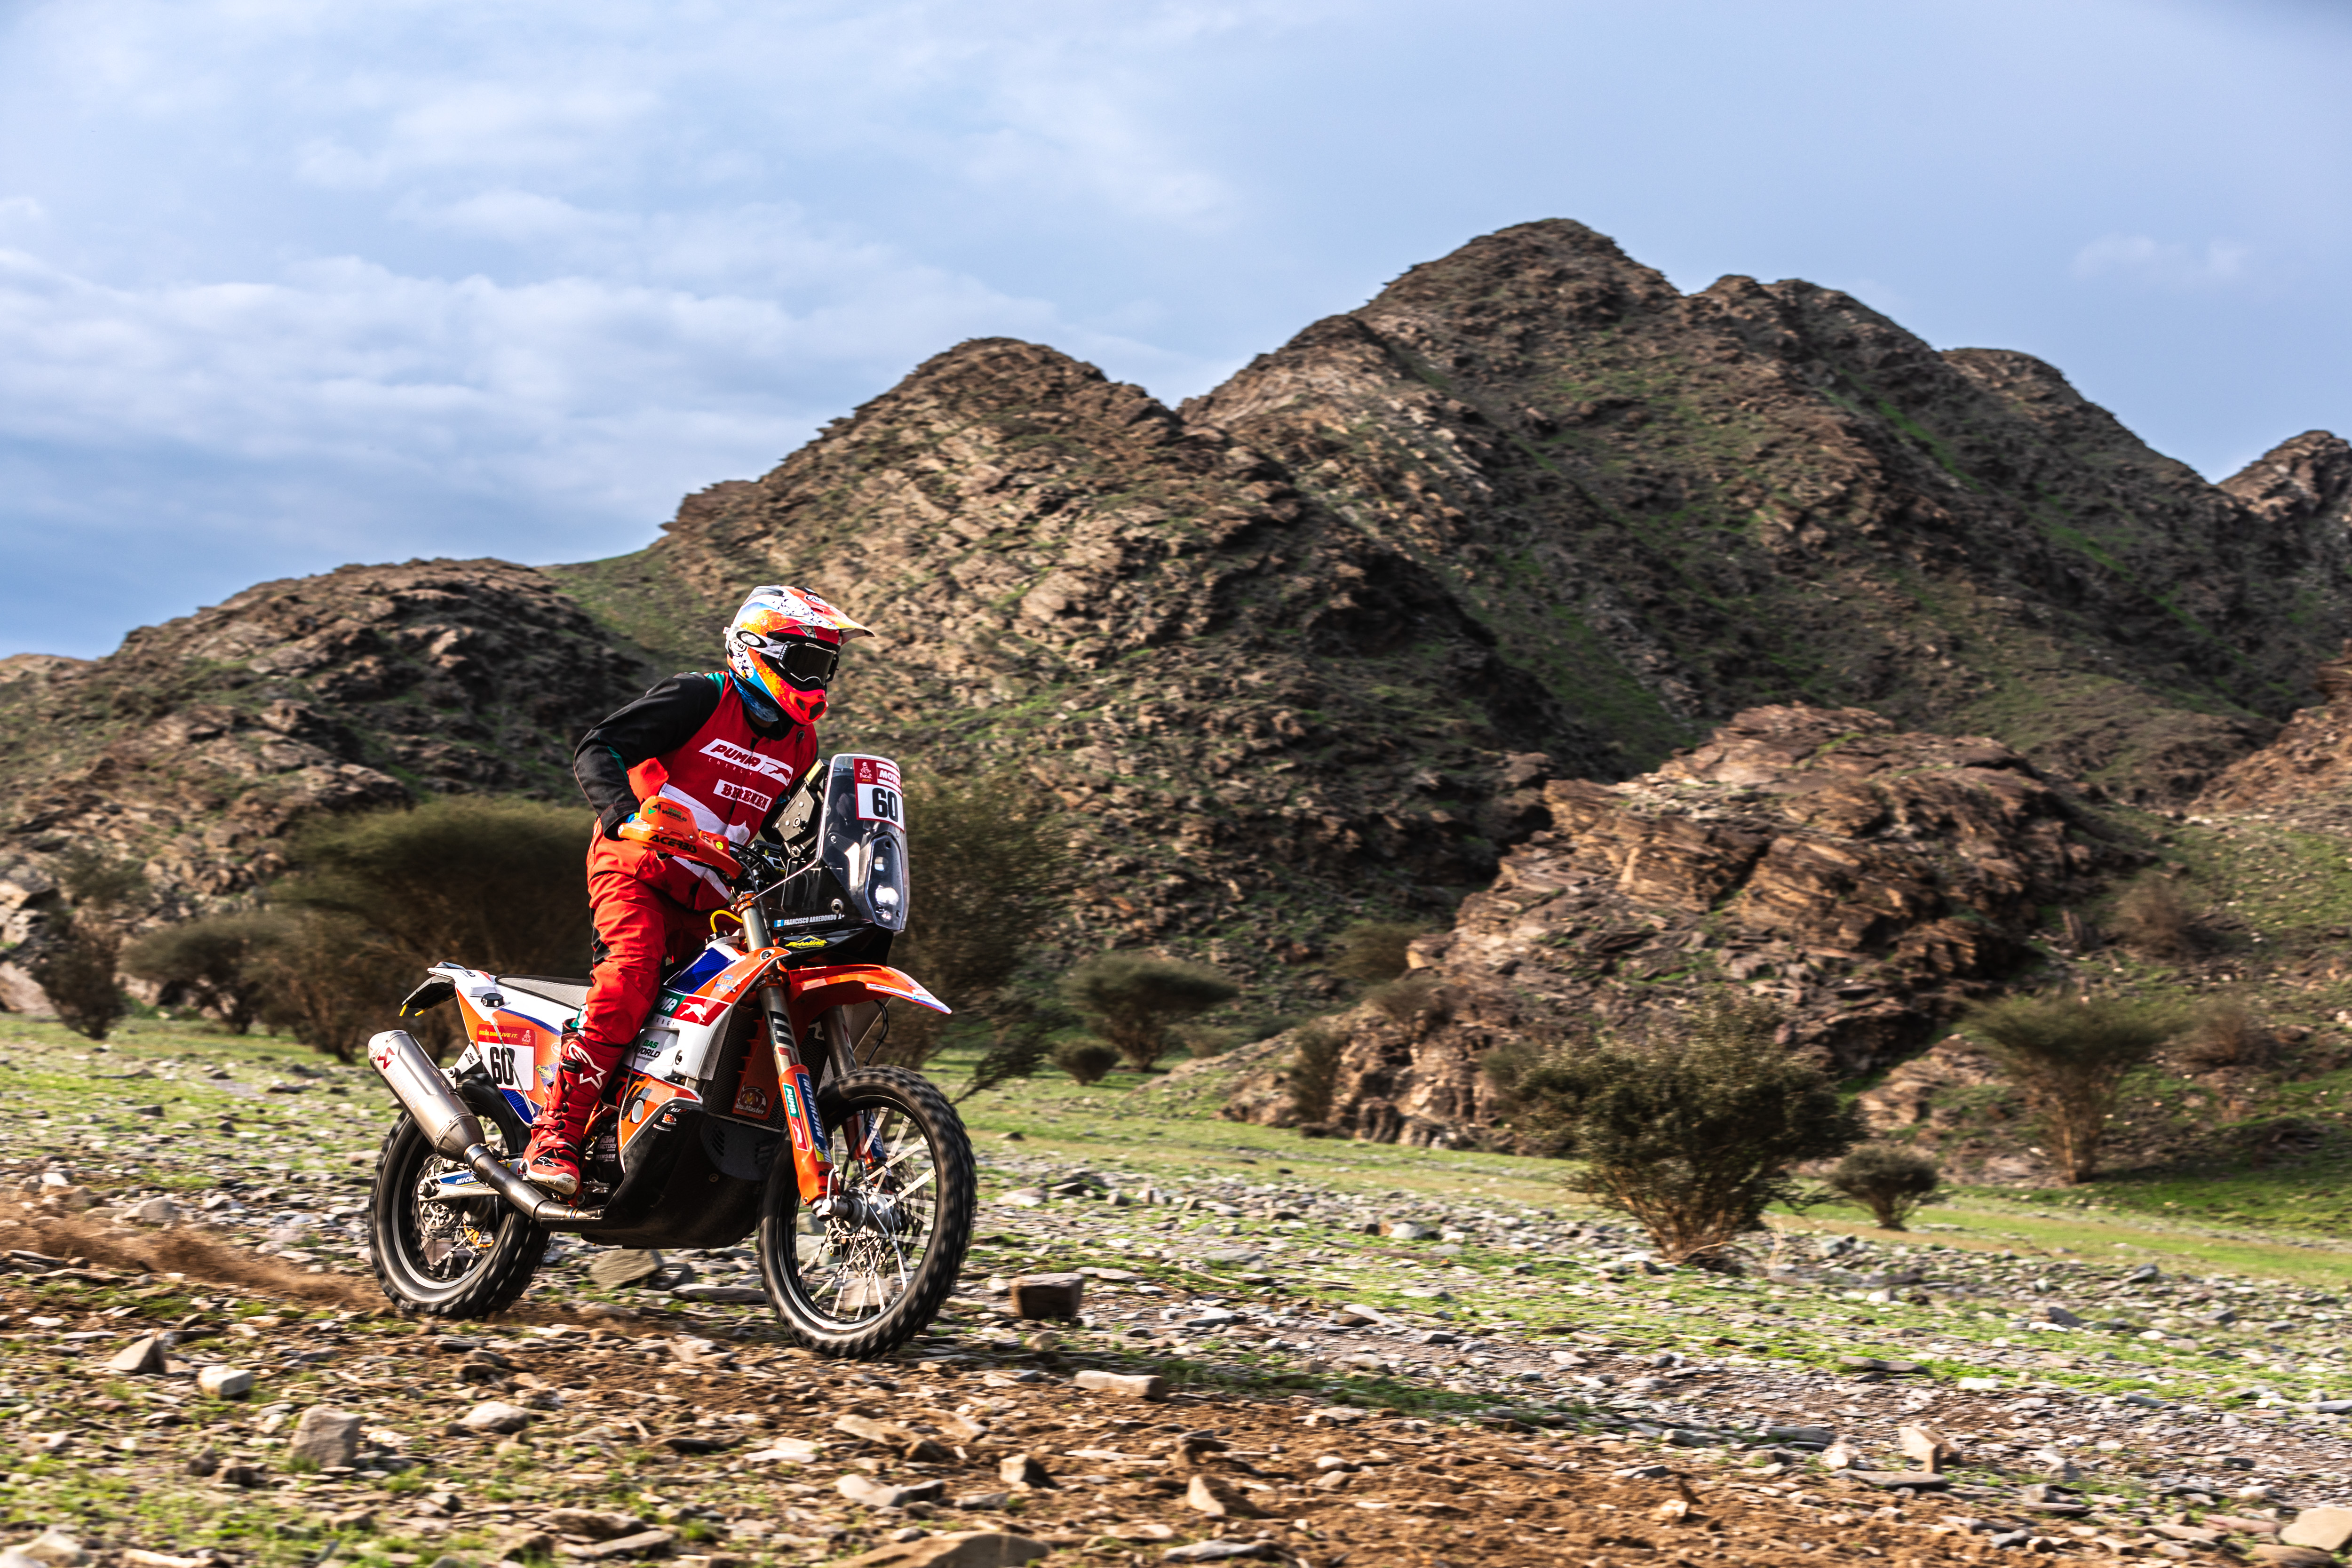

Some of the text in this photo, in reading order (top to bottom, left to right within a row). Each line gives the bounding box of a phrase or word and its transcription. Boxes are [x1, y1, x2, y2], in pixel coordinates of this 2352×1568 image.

[710, 744, 761, 767] PUMA
[708, 757, 753, 776] ENERGY
[721, 783, 769, 810] BREMEN
[872, 788, 898, 823] 60
[662, 809, 687, 822] WORLD
[649, 835, 698, 853] ACERBIS
[784, 917, 809, 926] FRANCISCO
[809, 914, 837, 923] ARREDONDO
[643, 1039, 659, 1049] BAS
[490, 1046, 515, 1086] 60
[786, 1088, 797, 1114] PUMA
[803, 1078, 824, 1138] MICHELIN
[599, 1135, 616, 1144] KTM
